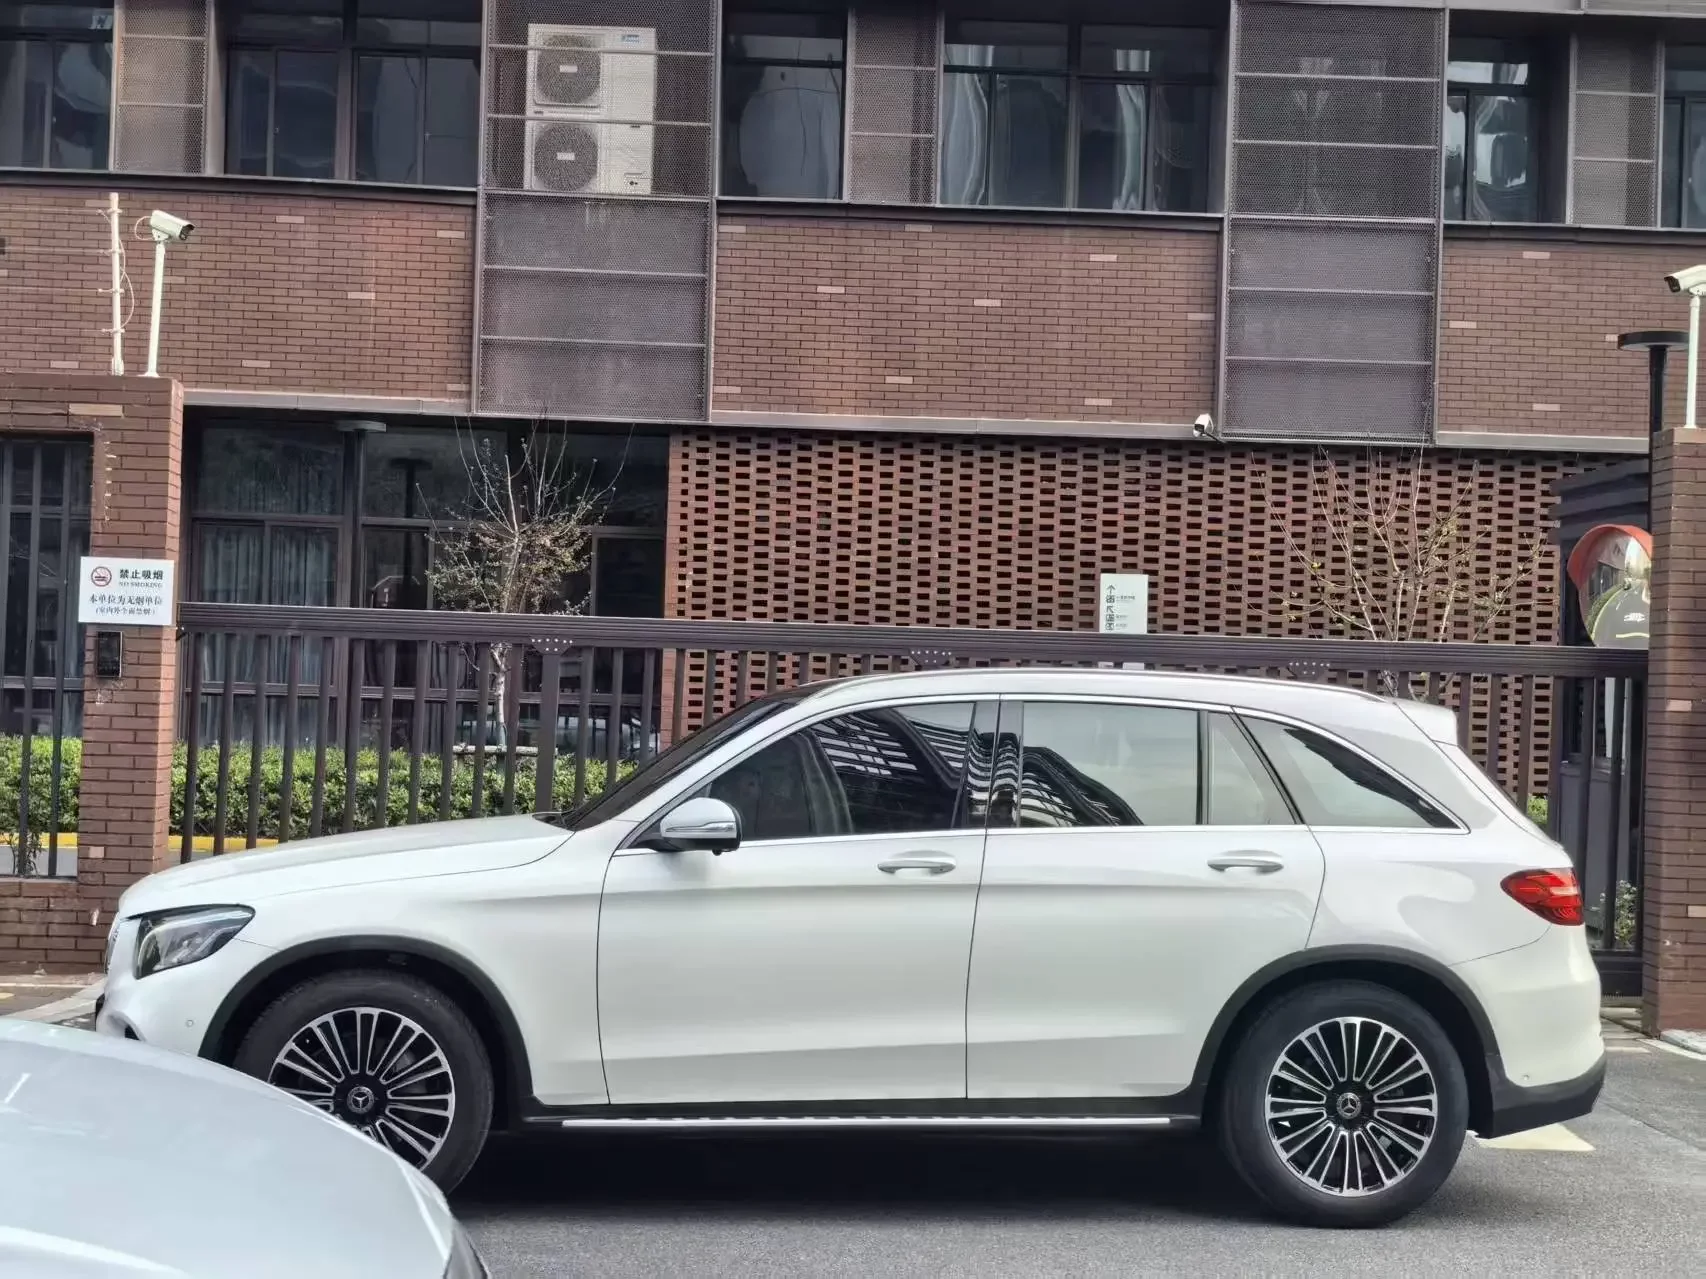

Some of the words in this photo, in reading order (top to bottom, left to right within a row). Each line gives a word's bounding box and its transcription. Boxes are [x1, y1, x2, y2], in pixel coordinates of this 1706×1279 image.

[119, 568, 164, 580] 禁止吸烟
[90, 593, 162, 605] 本单位为无烟单位
